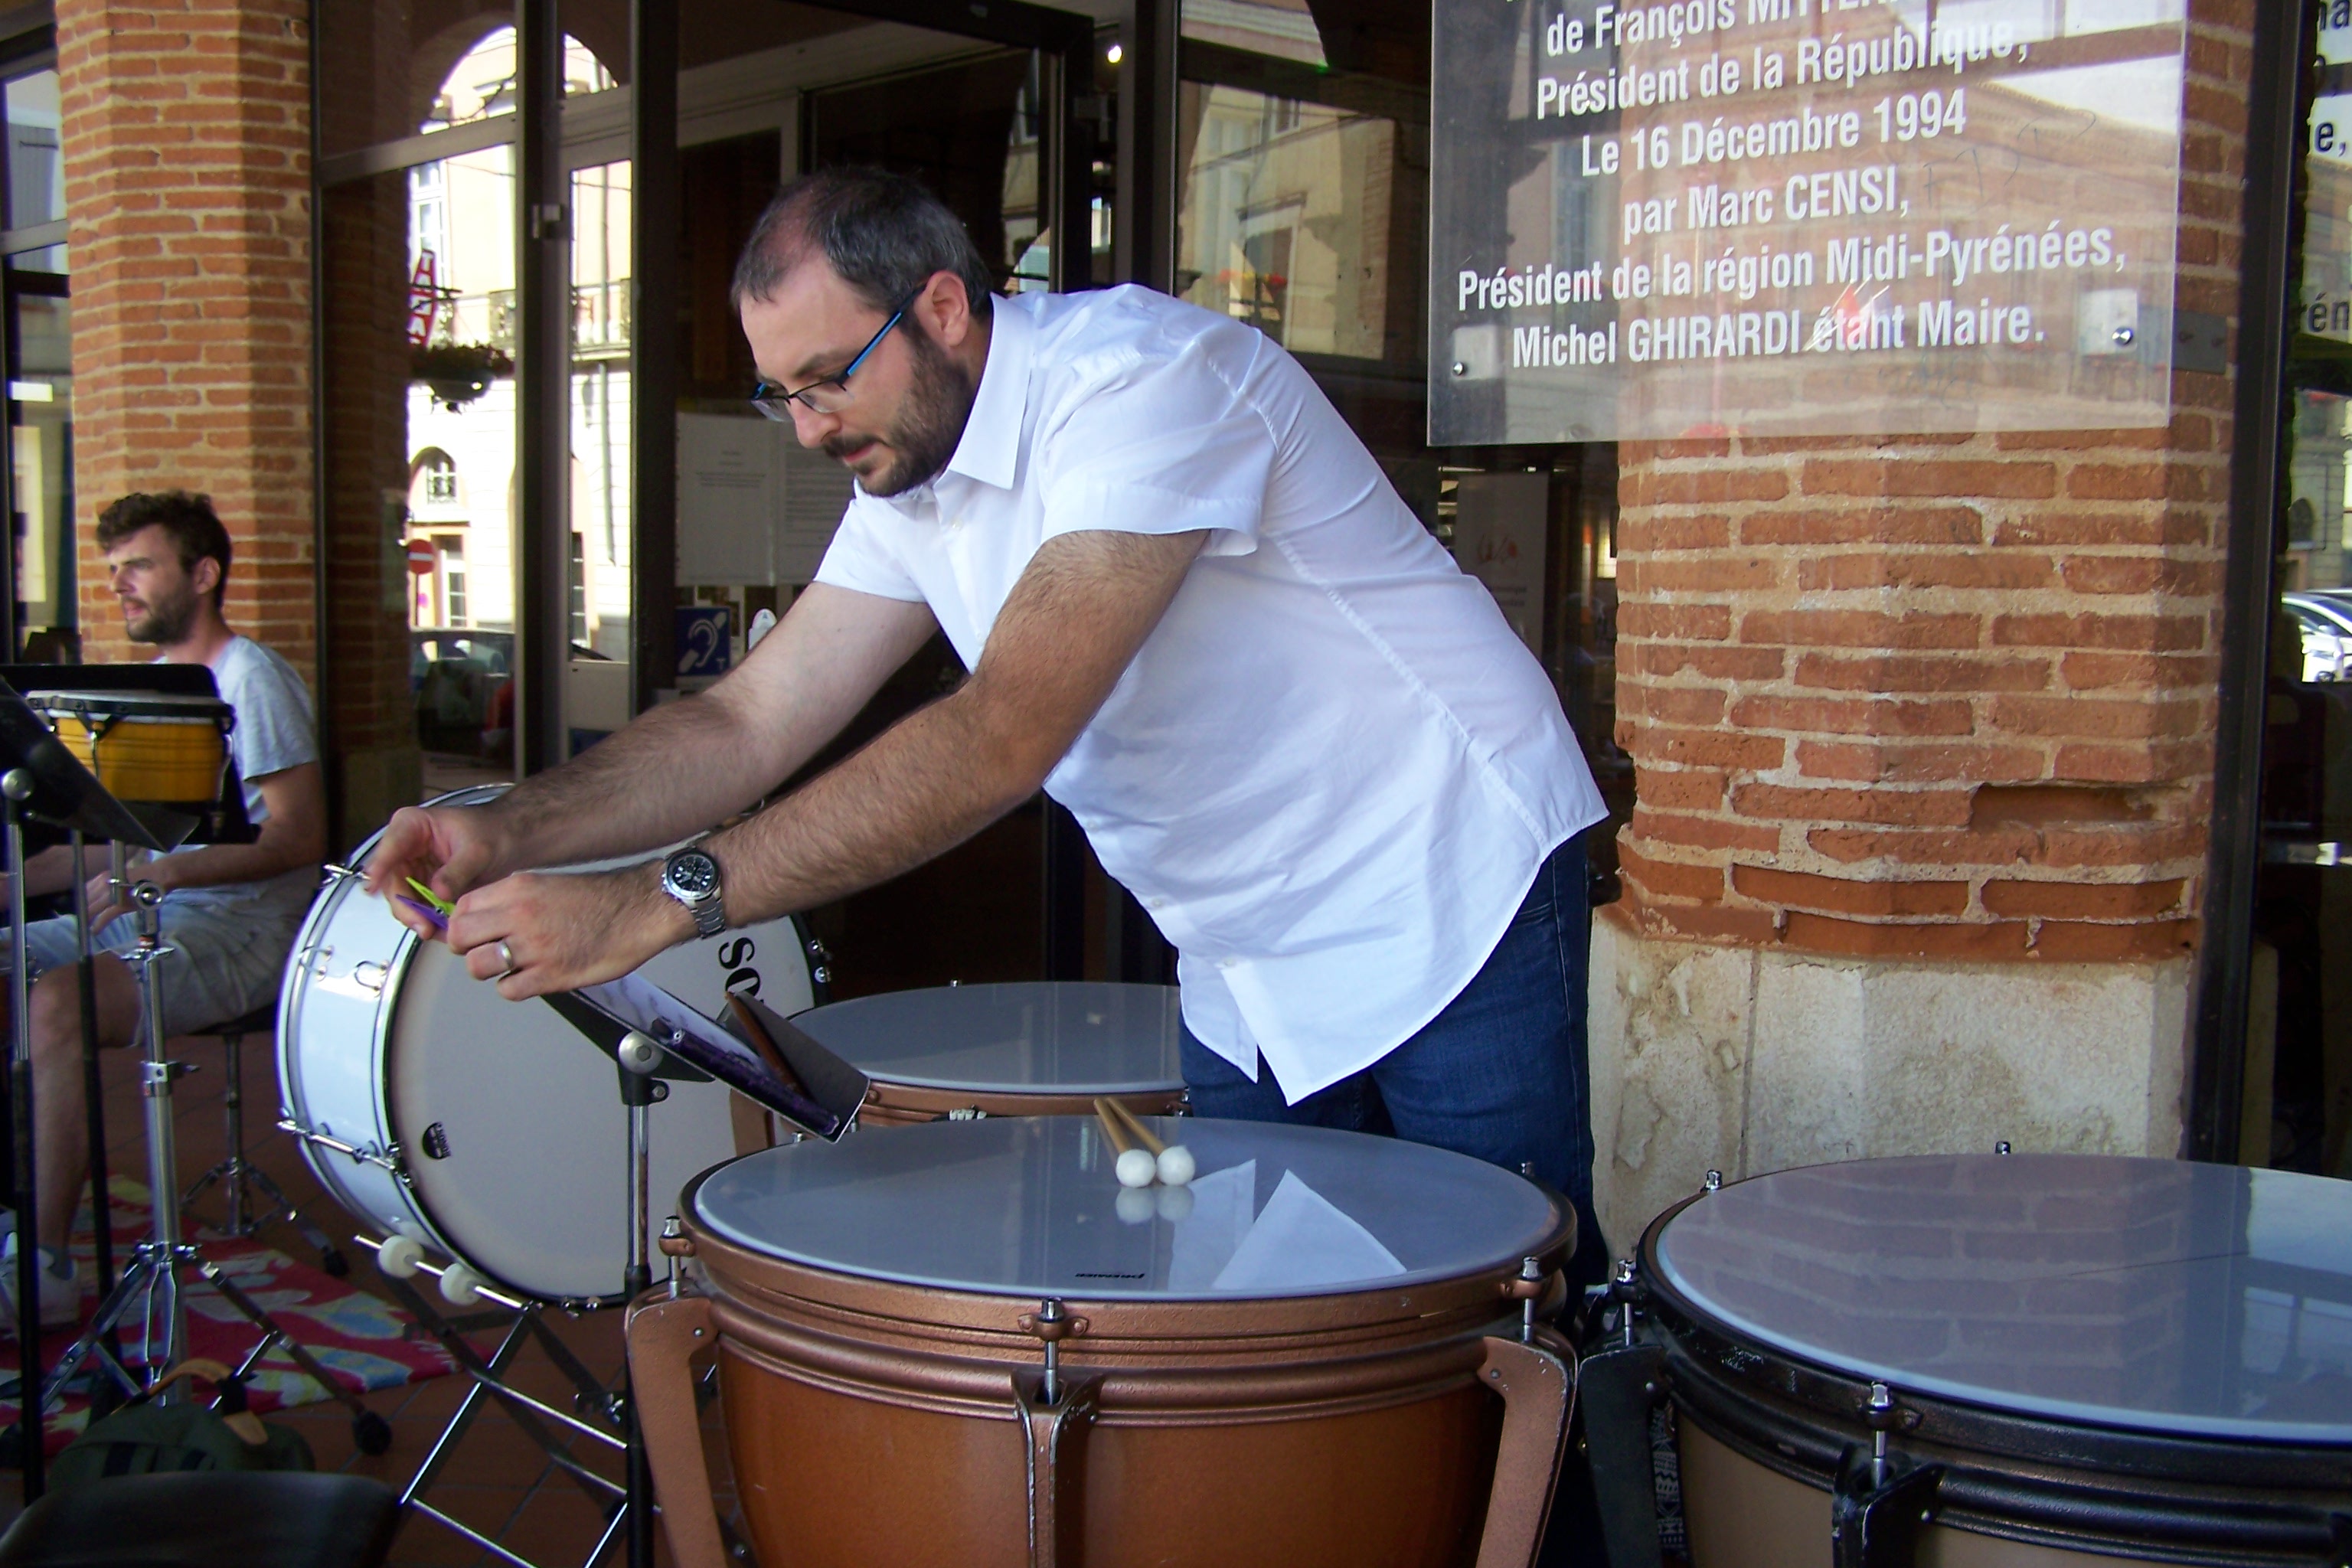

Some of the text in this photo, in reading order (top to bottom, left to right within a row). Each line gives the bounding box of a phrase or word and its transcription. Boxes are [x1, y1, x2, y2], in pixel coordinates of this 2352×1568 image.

[1547, 14, 1583, 57] de
[1595, 0, 1736, 49] François
[1537, 20, 2029, 119] Président de la République,
[1582, 88, 1967, 177] Le 16 Décembre 1994
[1624, 198, 1677, 245] par
[1688, 185, 1773, 230] Marc
[1785, 165, 1909, 220] CENSI,
[1459, 220, 2126, 311] Président de la région Midi-Pyrénées,
[1513, 298, 2045, 368] Michel GHIRARDI étant Maire.
[718, 937, 763, 1004] SO
